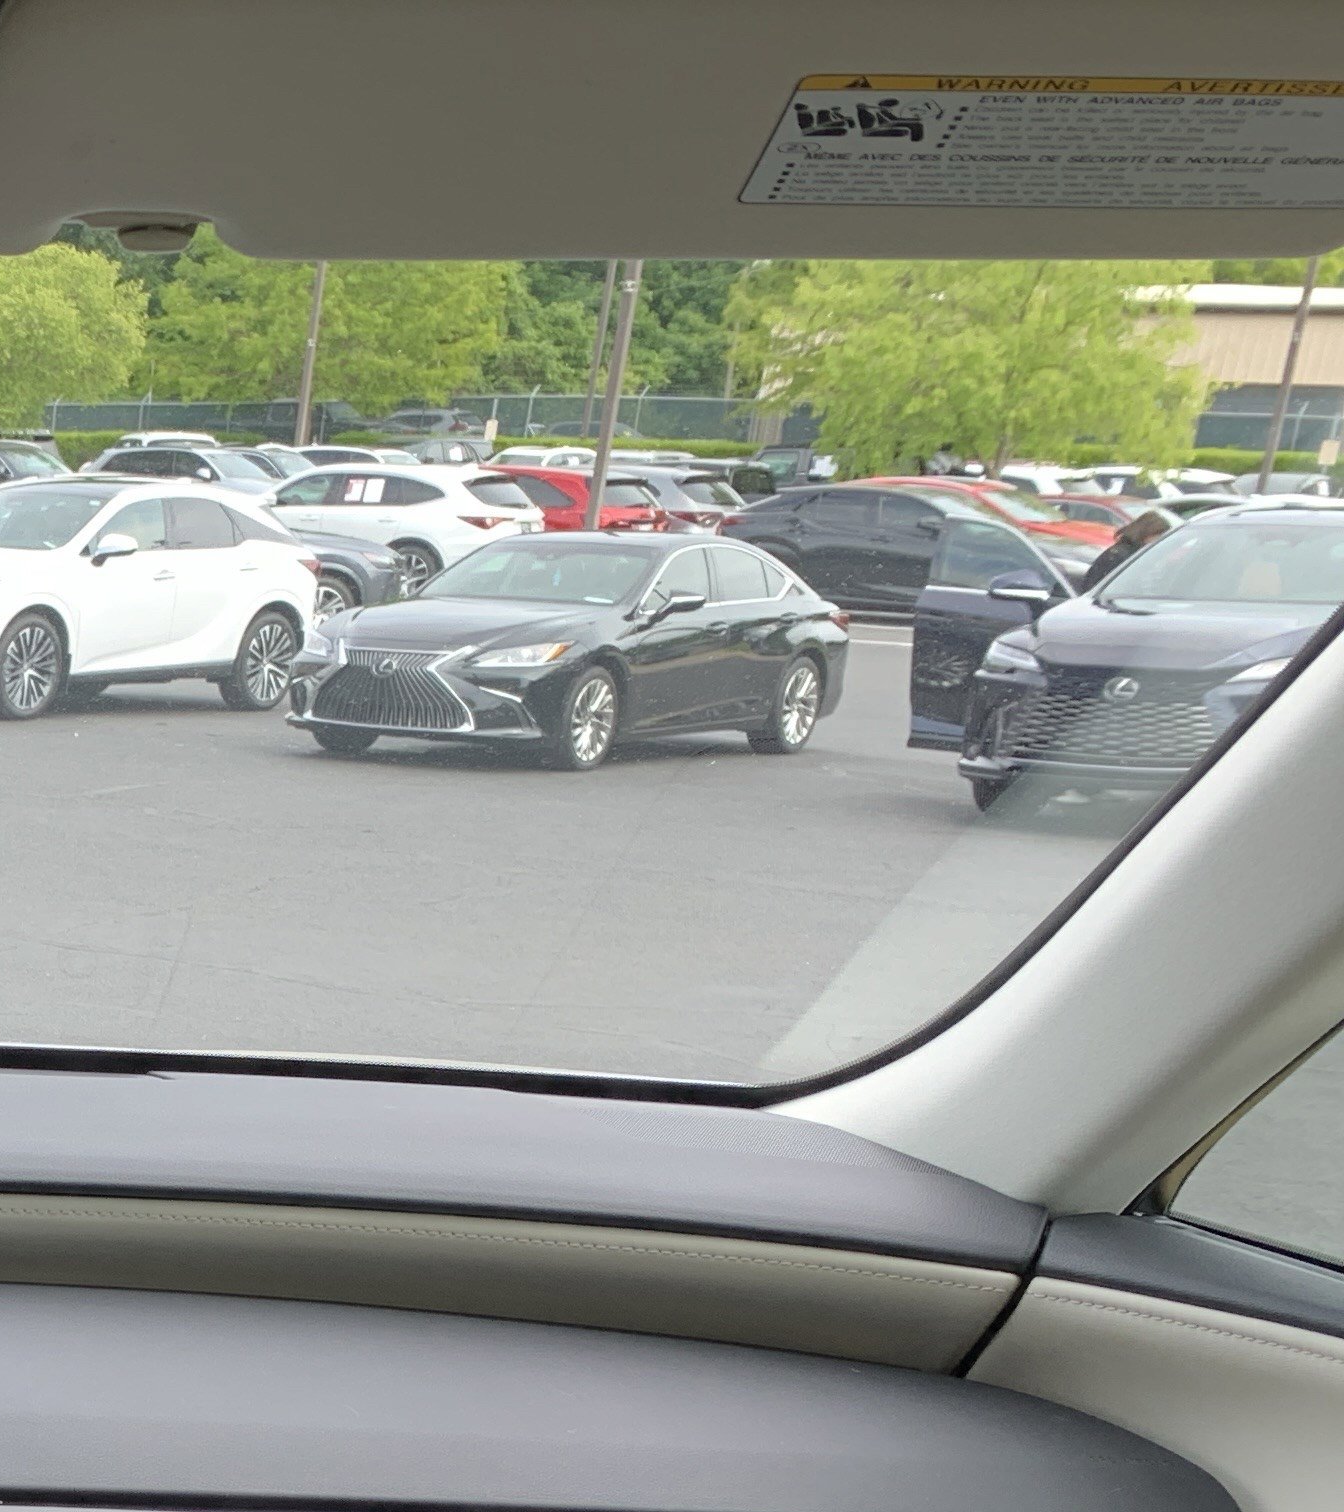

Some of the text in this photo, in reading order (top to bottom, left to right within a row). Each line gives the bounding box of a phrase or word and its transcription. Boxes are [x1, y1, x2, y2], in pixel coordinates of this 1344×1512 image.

[937, 78, 1091, 92] WARNING
[979, 96, 1283, 107] EVEN WITH ADVANCED AIR BAGS
[859, 152, 903, 161] AVEC
[908, 153, 942, 162] DES
[949, 153, 1031, 163] COUSSINS
[1038, 154, 1062, 163] DE
[1155, 155, 1181, 164] DE
[1184, 155, 1274, 165] NOUVELLE
